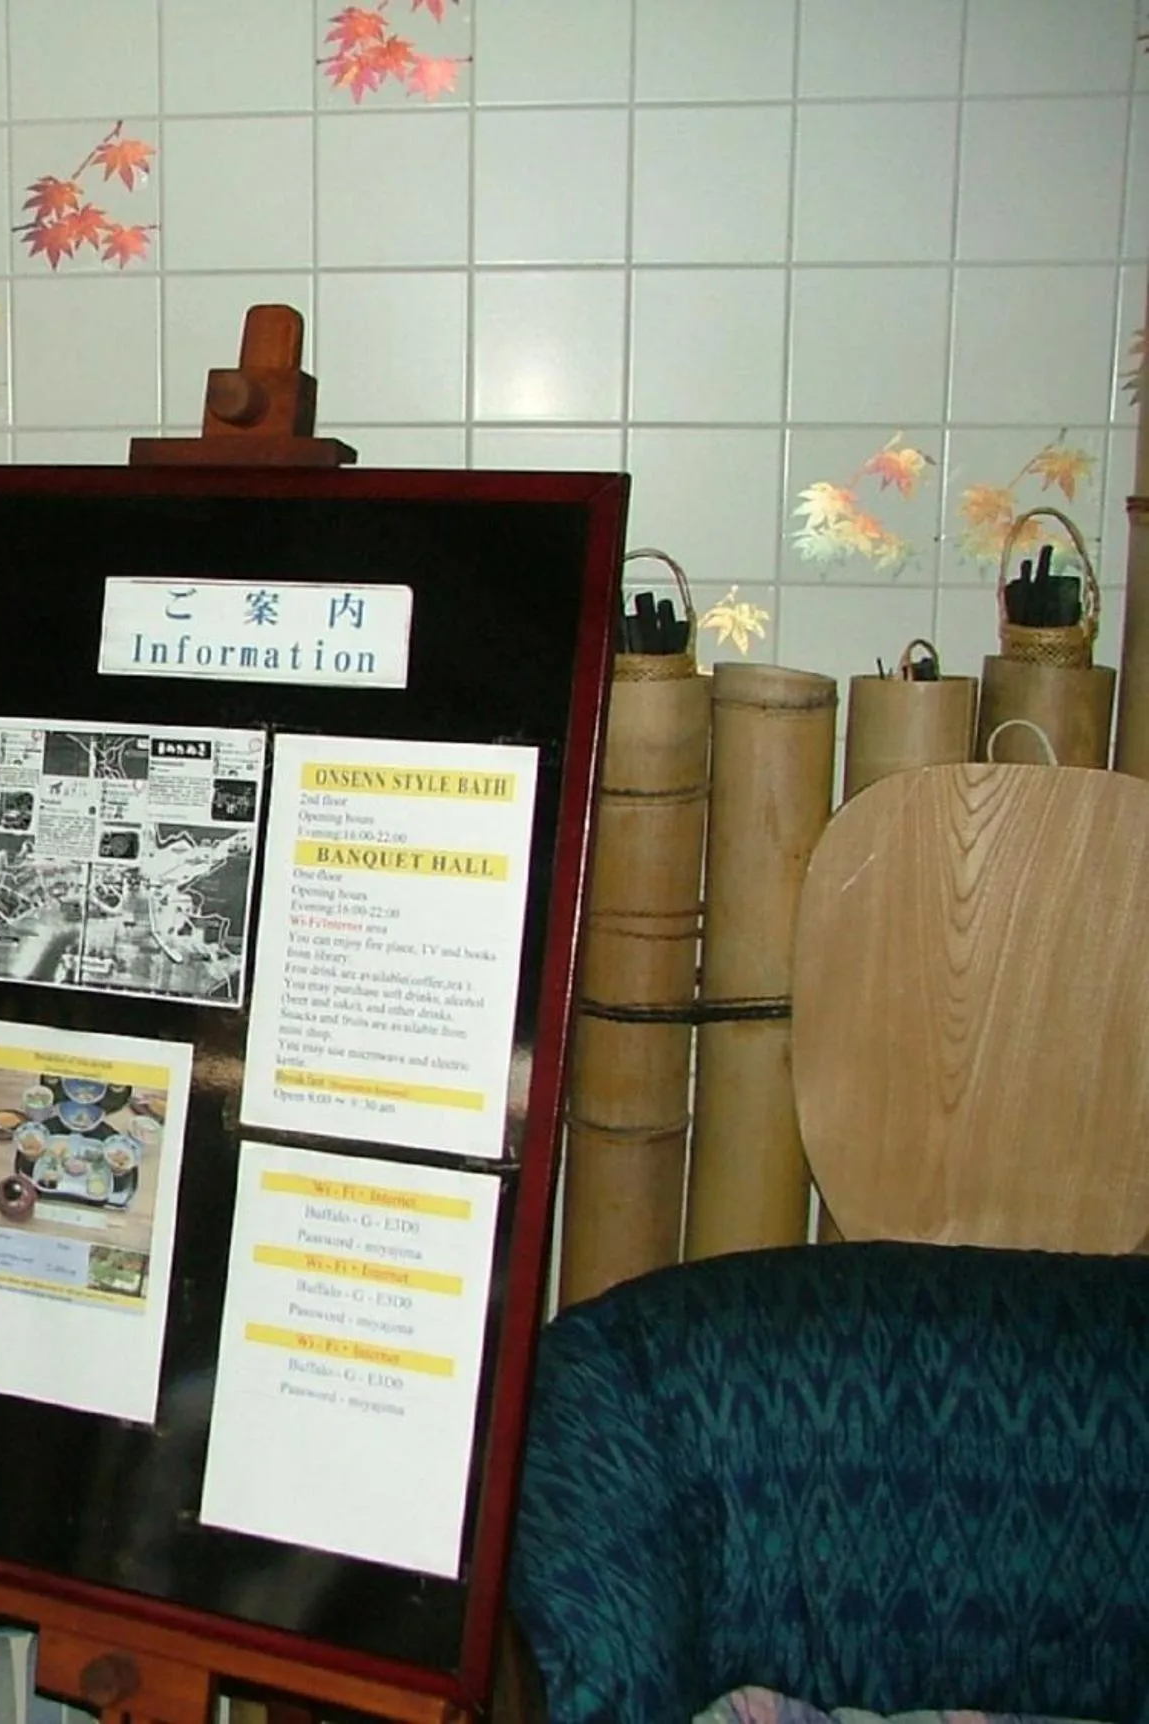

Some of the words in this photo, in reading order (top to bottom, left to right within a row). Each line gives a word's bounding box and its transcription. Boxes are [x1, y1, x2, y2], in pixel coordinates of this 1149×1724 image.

[165, 587, 365, 629] ご案内
[133, 634, 376, 673] Information
[316, 769, 386, 789] ONSENN
[392, 773, 450, 793] STYLE
[459, 777, 507, 797] BATH
[322, 794, 348, 807] floor
[298, 809, 342, 826] Opening
[345, 813, 375, 825] hours
[316, 847, 424, 870] BANQUET
[432, 856, 494, 877] HALL
[317, 869, 343, 881] floor
[291, 884, 335, 901] Opening
[338, 889, 368, 901] hours
[289, 931, 310, 944] You
[312, 934, 331, 945] can
[333, 935, 363, 951] enjoy
[441, 945, 461, 957] and
[284, 977, 306, 990] You
[307, 981, 330, 993] may
[311, 996, 330, 1007] and
[366, 1002, 386, 1014] and
[319, 1012, 339, 1024] and
[278, 1038, 299, 1051] You
[302, 1043, 324, 1056] may
[408, 1053, 428, 1066] and
[304, 1203, 351, 1223] Buffalo
[298, 1228, 354, 1249] Password
[296, 1277, 343, 1298] Buffalo
[288, 1301, 345, 1324] Password
[288, 1356, 333, 1376] Buffalo
[280, 1381, 337, 1403] Password
